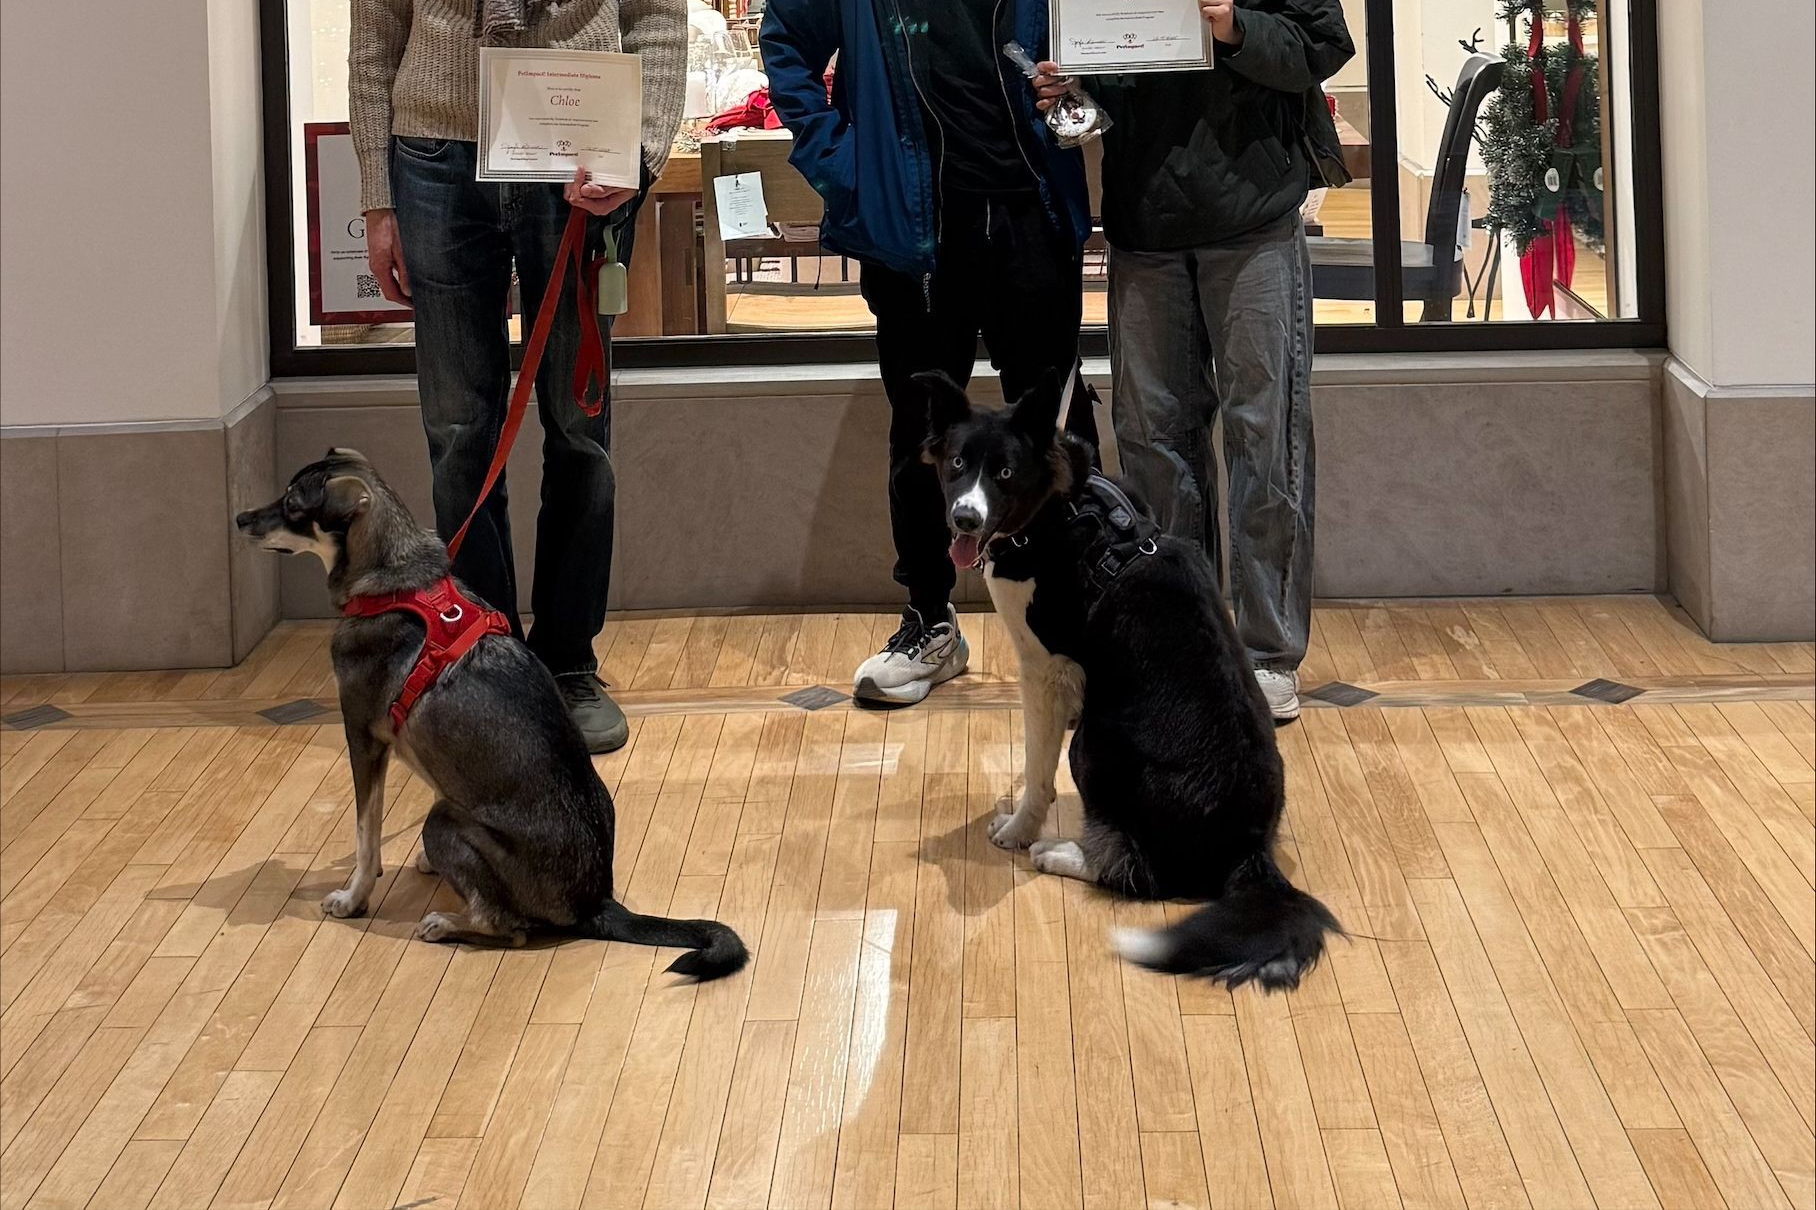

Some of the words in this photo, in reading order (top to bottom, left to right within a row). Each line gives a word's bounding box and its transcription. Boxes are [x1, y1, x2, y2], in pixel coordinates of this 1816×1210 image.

[547, 71, 579, 79] Intermediate
[579, 72, 601, 80] Diploma
[550, 94, 581, 107] Chloe
